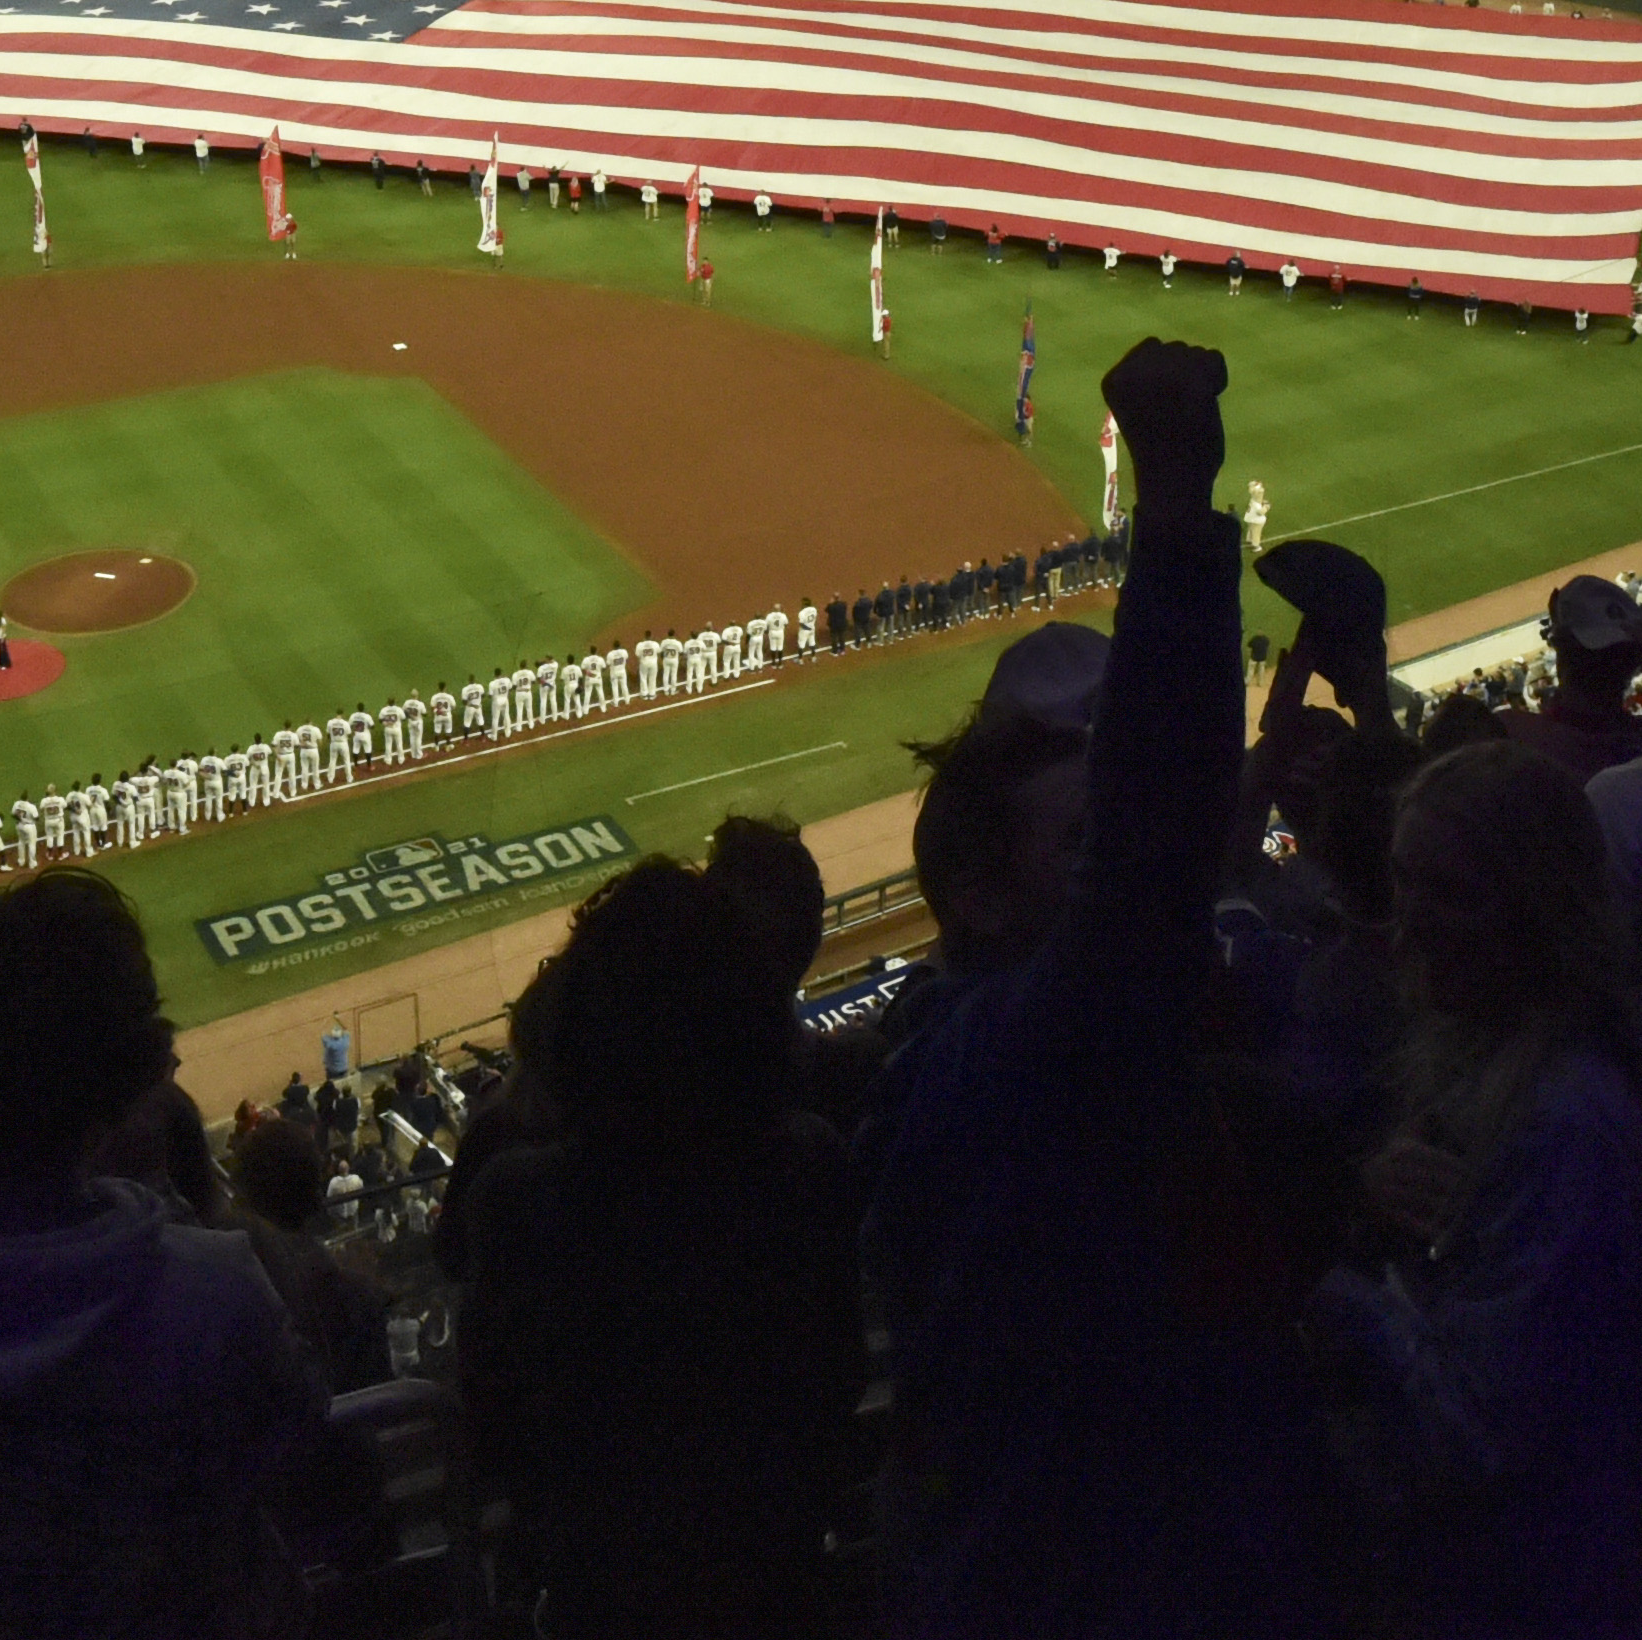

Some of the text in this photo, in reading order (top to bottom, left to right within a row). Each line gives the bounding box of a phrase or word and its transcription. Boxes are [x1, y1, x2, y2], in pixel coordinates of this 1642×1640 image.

[209, 820, 625, 958] POSTSEASON
[324, 836, 487, 887] 20 21
